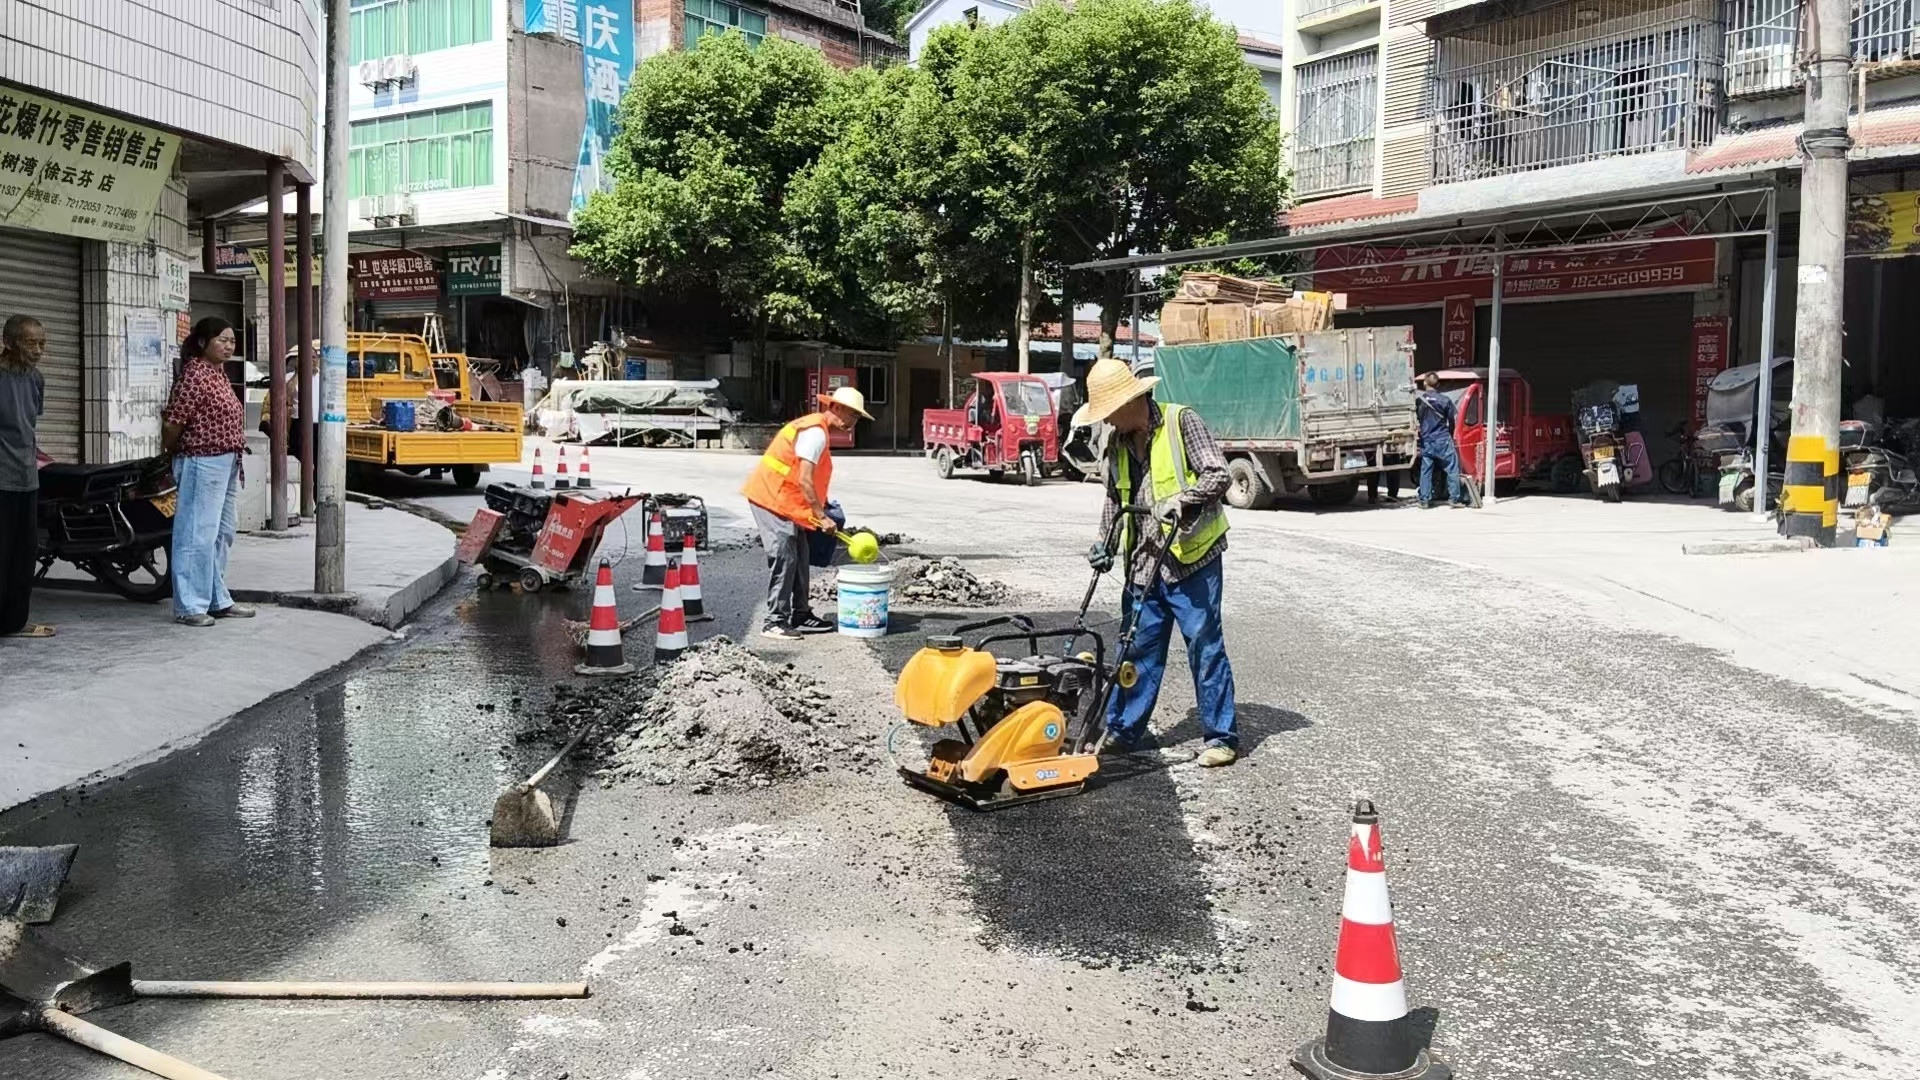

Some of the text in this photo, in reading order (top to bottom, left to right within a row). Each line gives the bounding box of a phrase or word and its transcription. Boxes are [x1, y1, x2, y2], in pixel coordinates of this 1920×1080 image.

[0, 94, 166, 171] 花爆竹零售销售点
[1, 151, 116, 193] 树湾 徐云芬 店
[65, 196, 101, 213] 72172053
[448, 256, 484, 276] TRY
[1571, 266, 1684, 288] 18225209939
